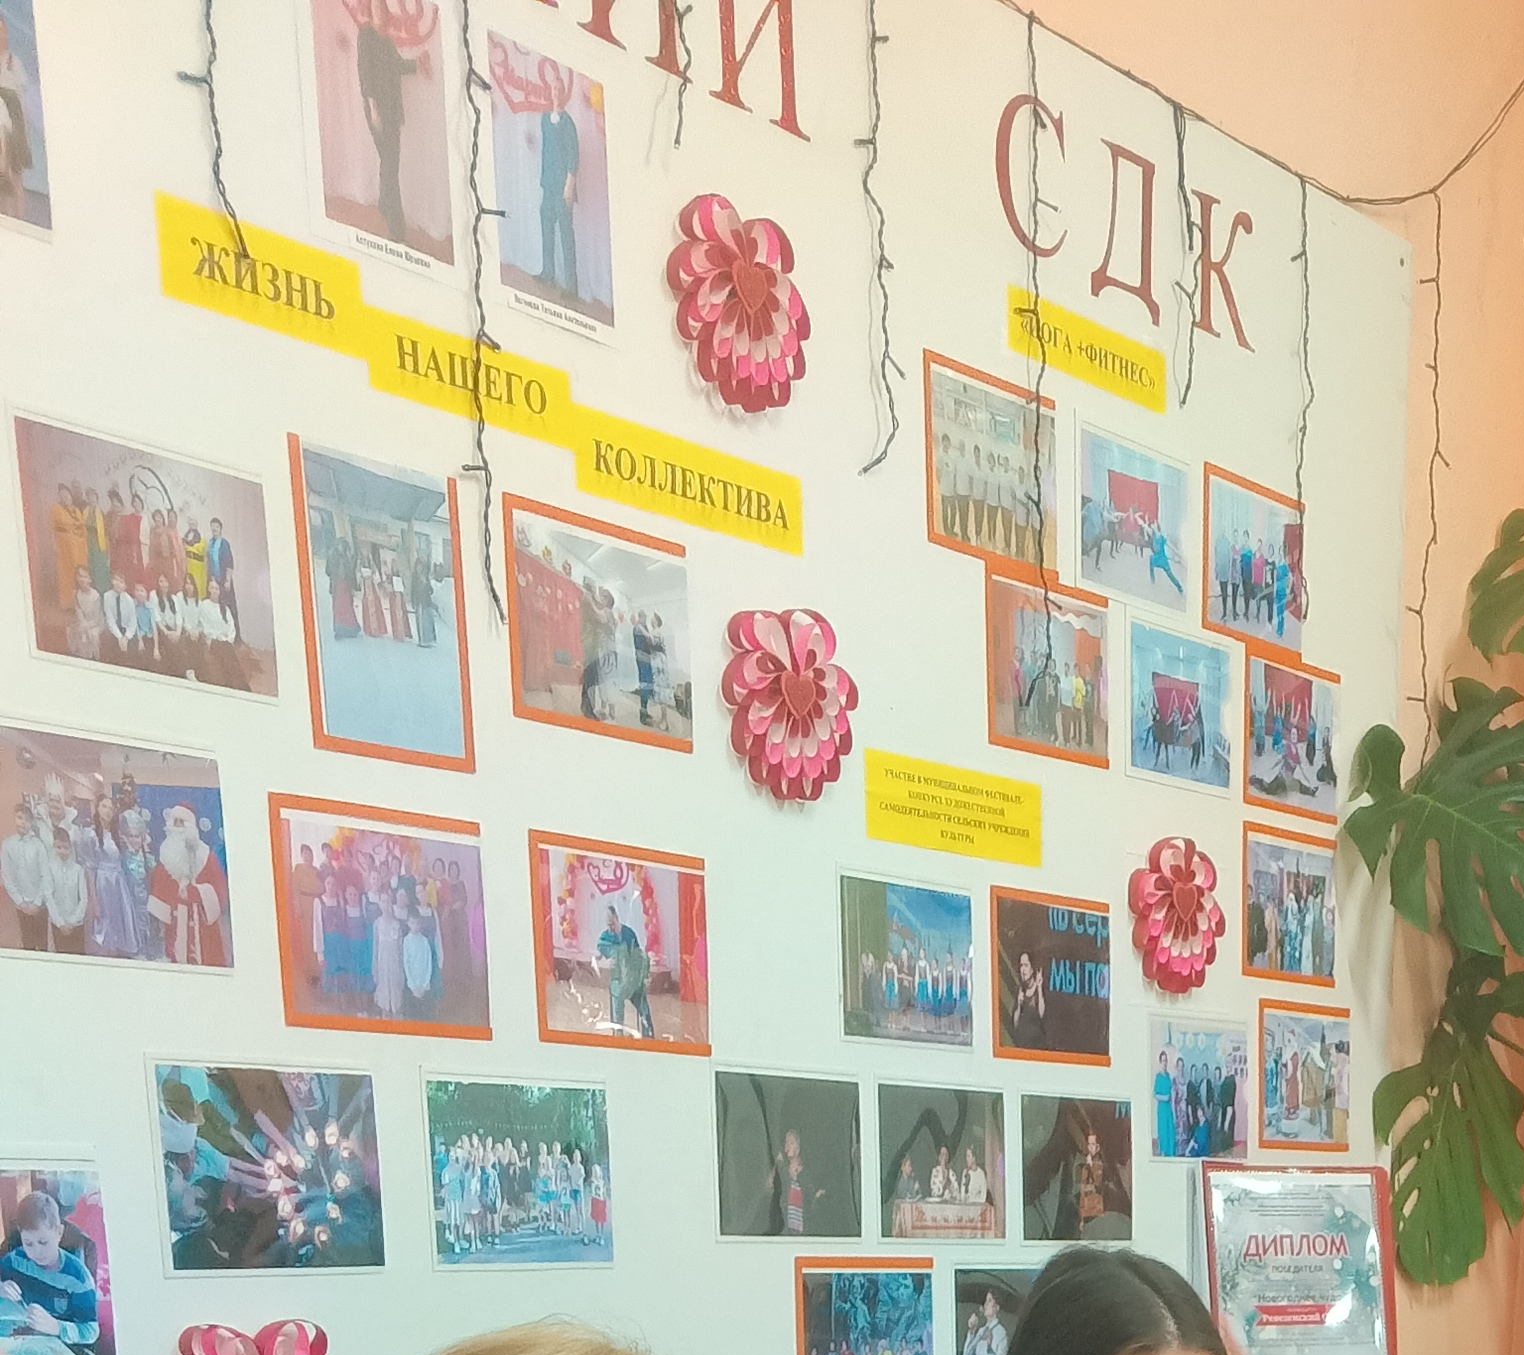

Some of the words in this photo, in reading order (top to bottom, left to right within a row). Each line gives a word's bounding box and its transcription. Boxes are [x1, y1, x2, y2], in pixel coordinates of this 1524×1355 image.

[995, 94, 1254, 353] СДК
[190, 236, 336, 321] ЖИЗНЬ
[395, 333, 548, 417] НАШЕГО
[592, 438, 791, 531] КОЛЛЕКТИВА
[1243, 1233, 1349, 1264] ДИПЛОМ
